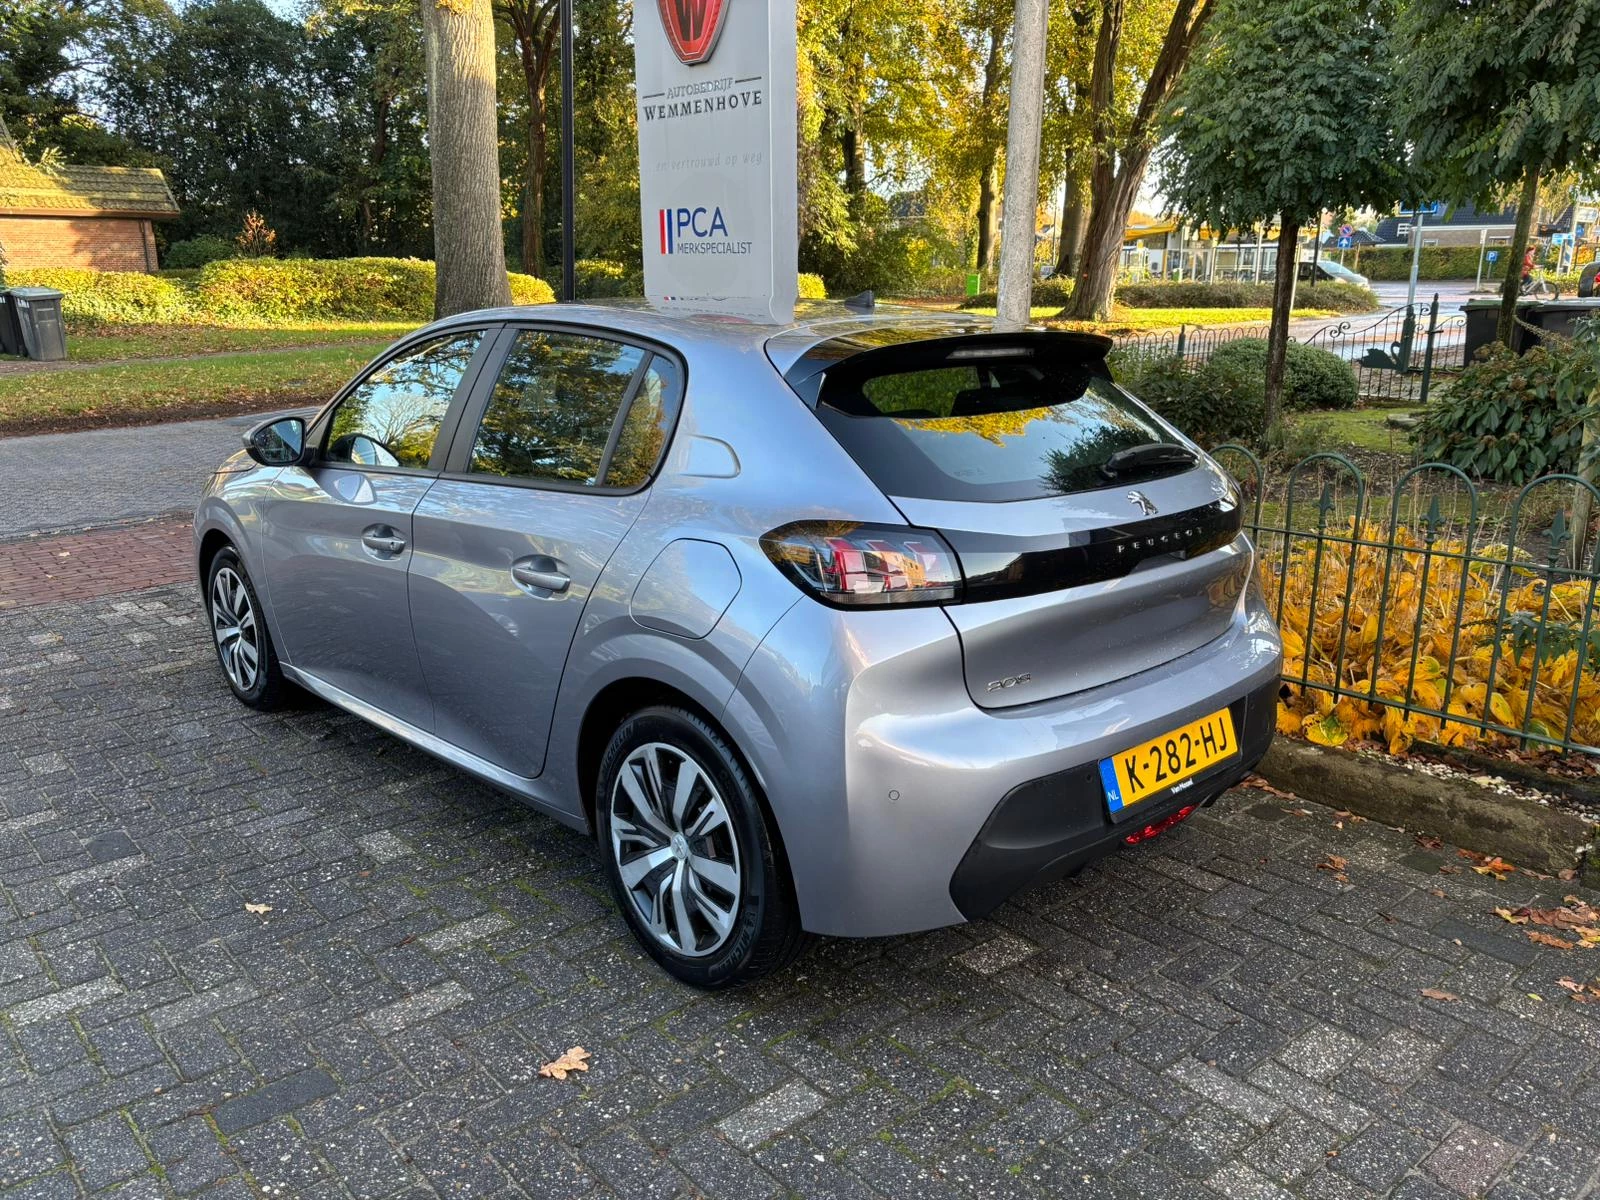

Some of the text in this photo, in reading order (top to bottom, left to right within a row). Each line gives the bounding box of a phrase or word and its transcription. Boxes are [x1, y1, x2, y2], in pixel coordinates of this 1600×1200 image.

[666, 78, 733, 99] AUTOBEDRIJF
[642, 90, 762, 121] WEMMENHOVE
[725, 153, 738, 168] op
[742, 150, 763, 168] weg
[677, 206, 728, 238] PCA
[677, 242, 752, 255] MERKSPECIALIST
[1117, 526, 1203, 554] PEUGEOT
[1124, 717, 1228, 794] K-282-HJ
[1106, 789, 1119, 802] NL
